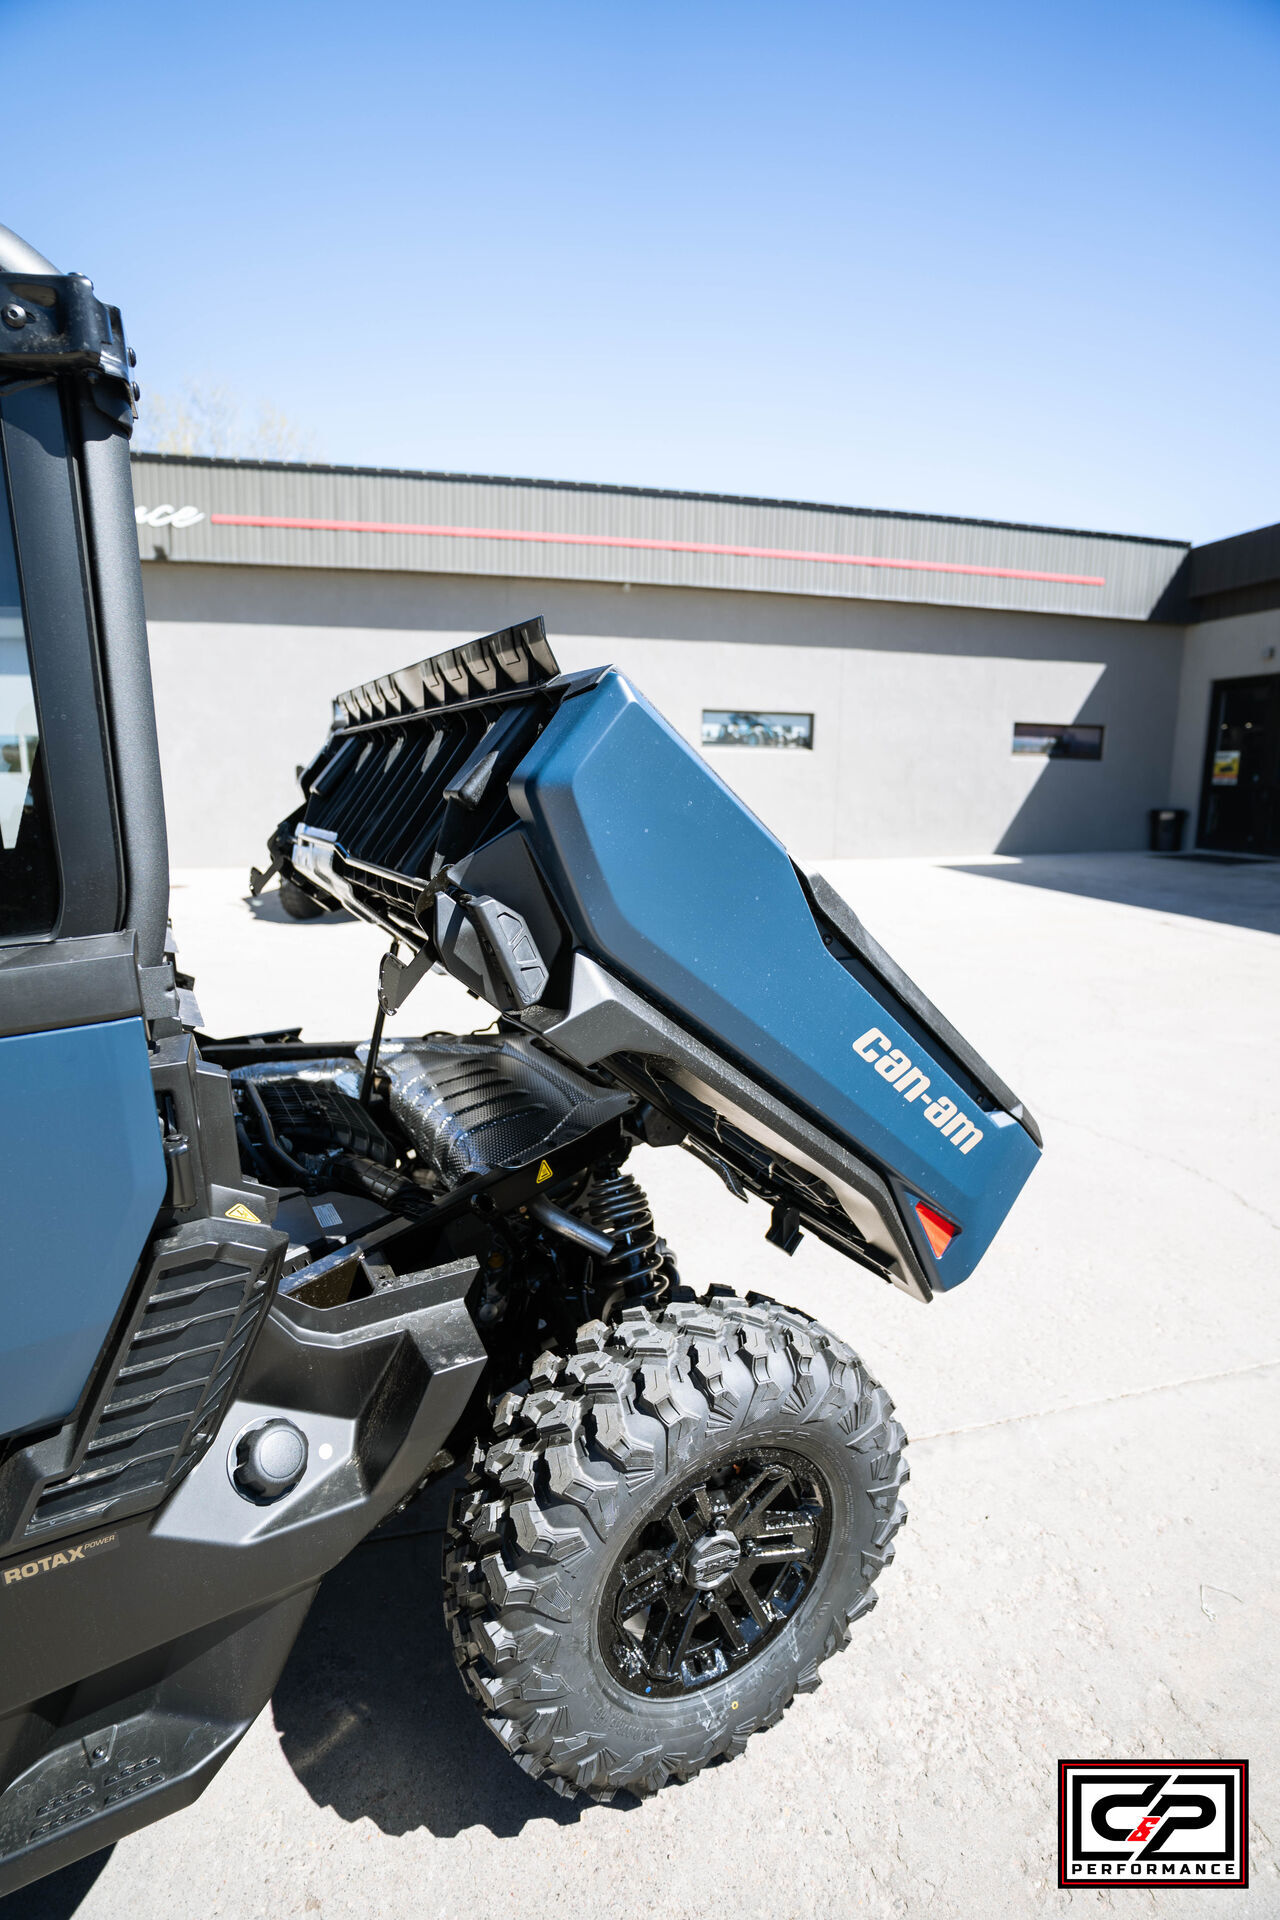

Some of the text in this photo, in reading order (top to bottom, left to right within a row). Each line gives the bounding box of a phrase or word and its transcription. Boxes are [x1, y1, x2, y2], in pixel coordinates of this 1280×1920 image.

[852, 1027, 984, 1155] can-am
[4, 1534, 116, 1585] ROTAX POWER
